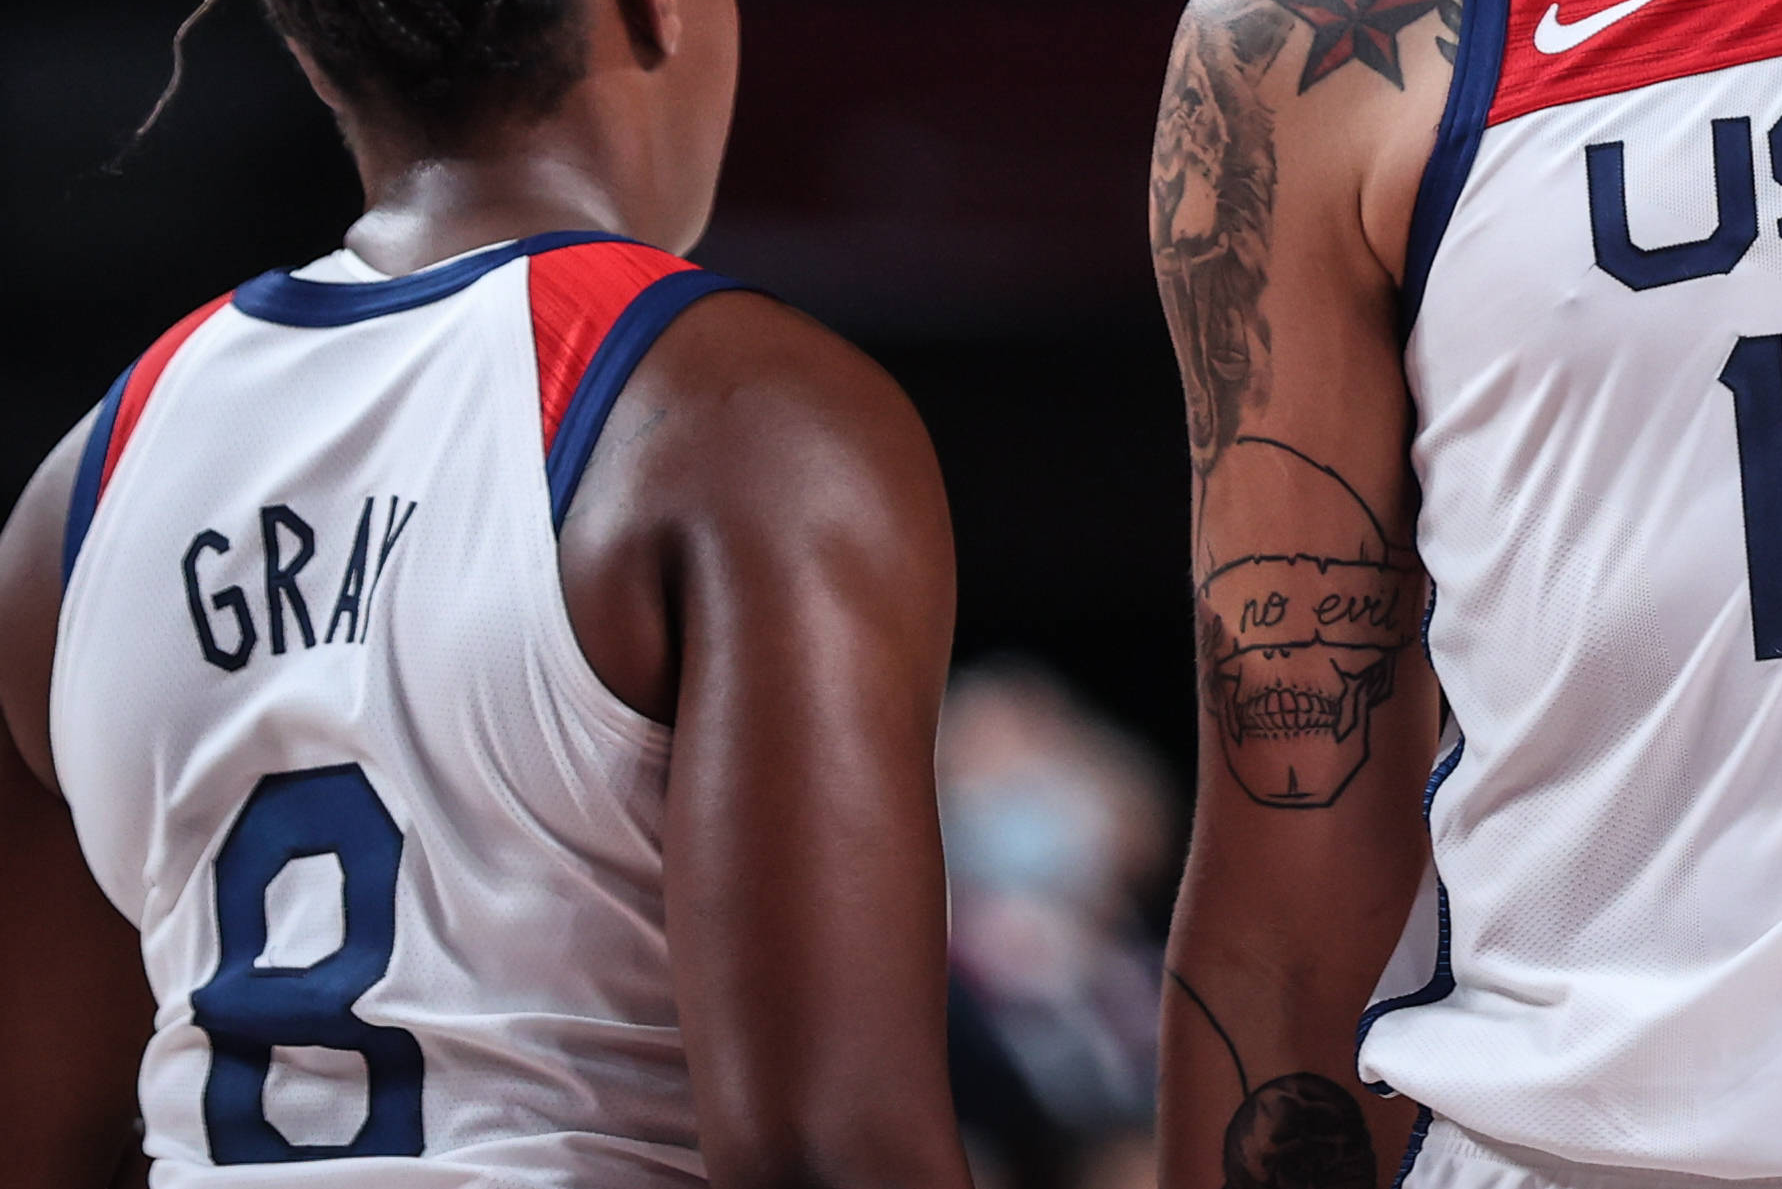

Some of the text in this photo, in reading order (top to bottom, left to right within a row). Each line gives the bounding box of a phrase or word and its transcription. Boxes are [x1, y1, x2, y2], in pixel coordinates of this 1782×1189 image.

[182, 495, 418, 673] GRAY
[1239, 587, 1401, 634] no evil
[190, 762, 425, 1165] 8
